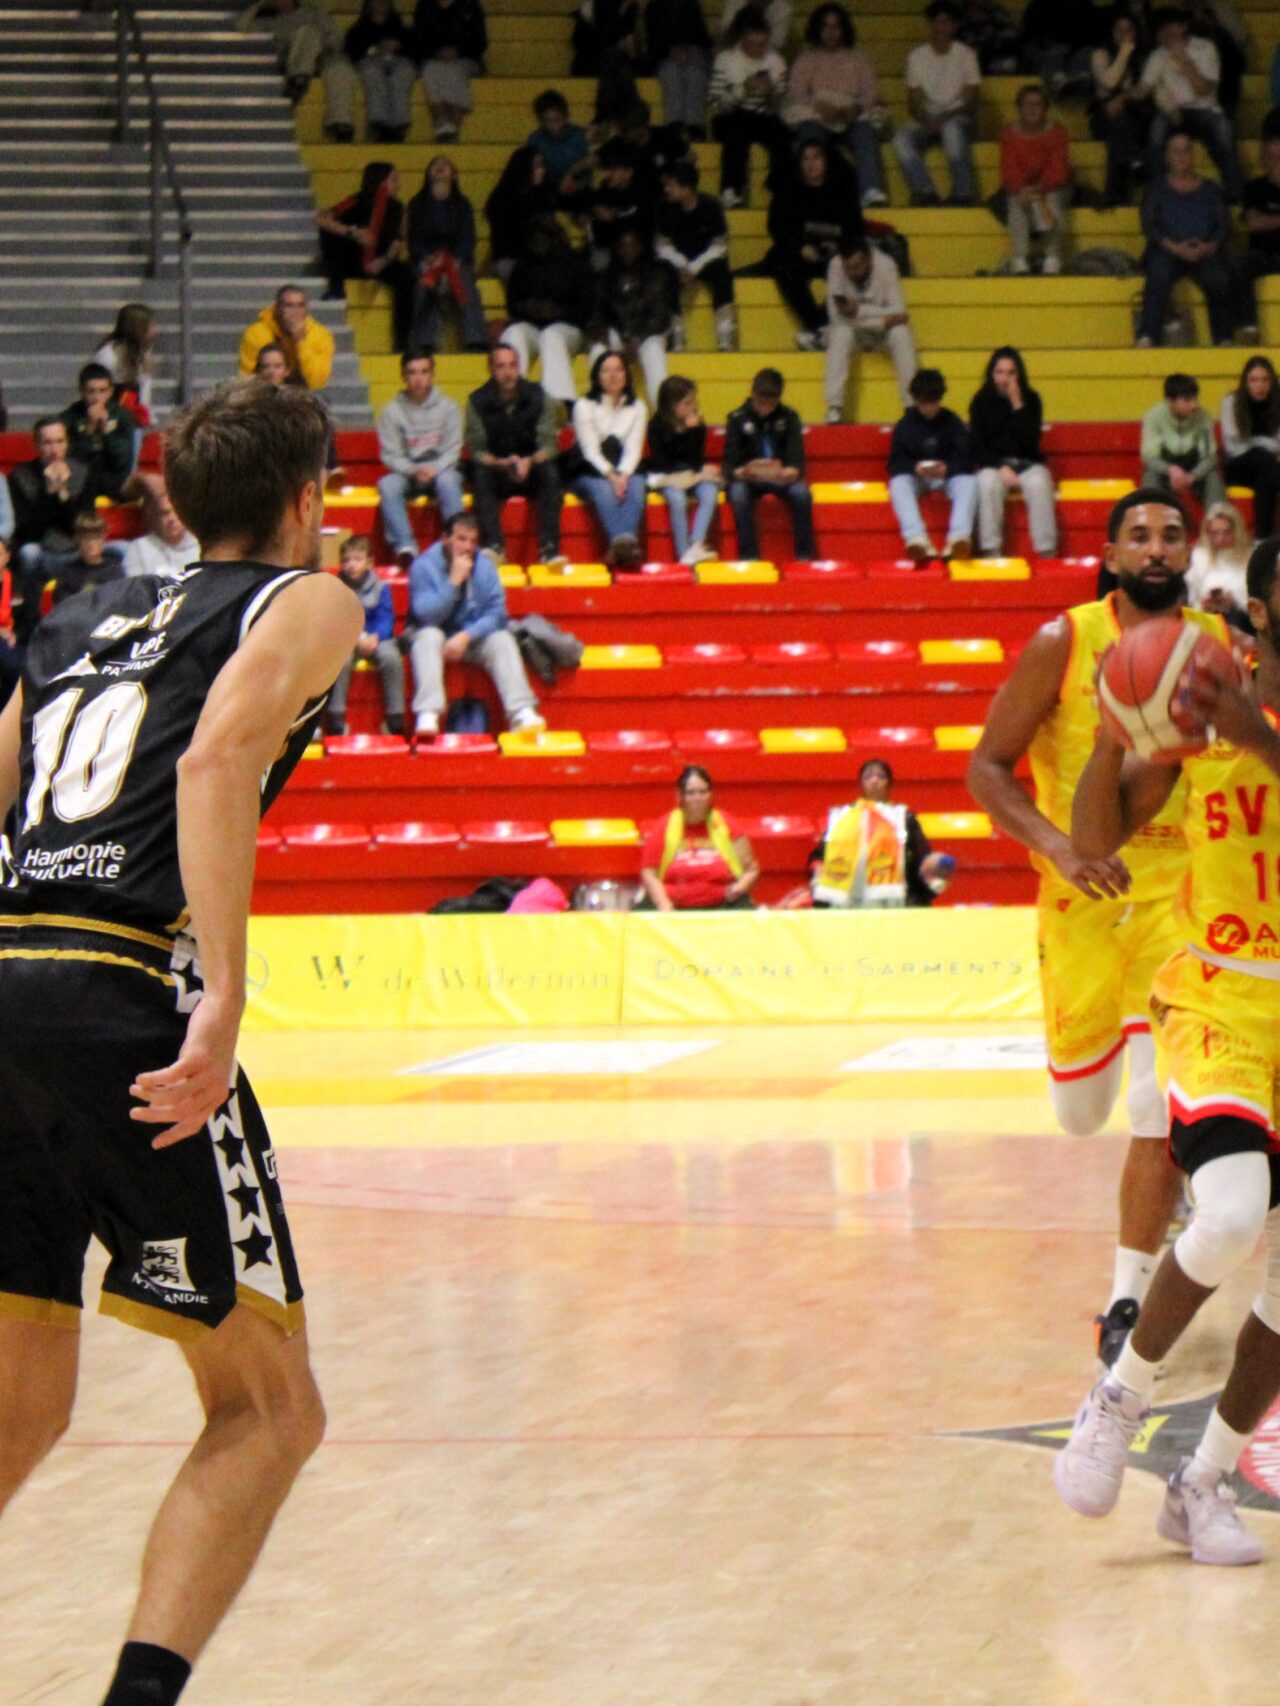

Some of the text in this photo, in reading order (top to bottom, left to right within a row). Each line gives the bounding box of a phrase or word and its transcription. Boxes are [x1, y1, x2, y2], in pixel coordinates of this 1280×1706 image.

[22, 681, 147, 834] 10
[23, 841, 126, 867] Harmonie
[132, 1272, 209, 1304] NANDIE
